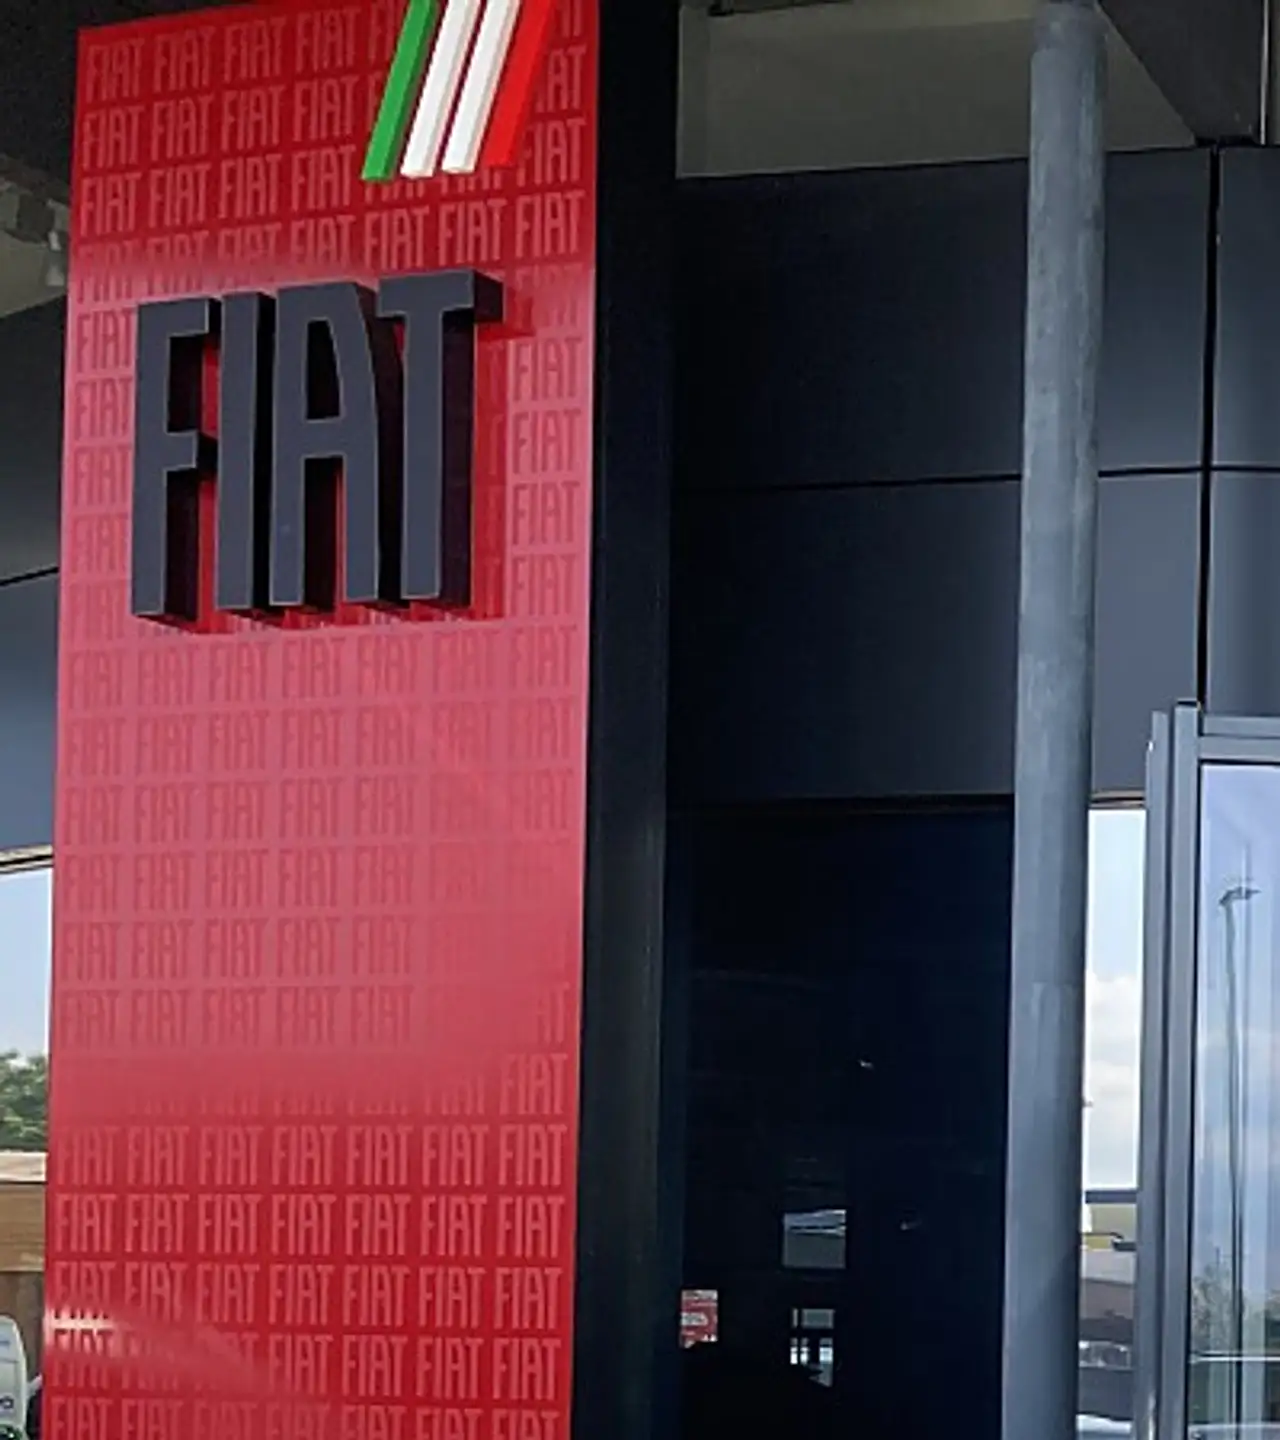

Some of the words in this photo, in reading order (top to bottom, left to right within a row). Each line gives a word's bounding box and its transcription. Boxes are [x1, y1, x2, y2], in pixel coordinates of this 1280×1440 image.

[87, 38, 143, 102] FIAT
[155, 29, 212, 91] FIAT
[224, 19, 283, 81] FIAT
[296, 8, 356, 71] FIAT
[84, 106, 141, 168] FIAT
[153, 97, 210, 159] FIAT
[223, 88, 282, 150] FIAT
[294, 78, 355, 140] FIAT
[82, 174, 139, 235] FIAT
[151, 166, 208, 227] FIAT
[221, 158, 280, 218] FIAT
[293, 149, 354, 210] FIAT
[291, 219, 352, 279] FIAT
[365, 210, 428, 272] FIAT
[440, 201, 505, 264] FIAT
[517, 191, 585, 256] FIAT
[78, 310, 135, 369] FIAT
[76, 378, 133, 437] FIAT
[514, 337, 582, 400] FIAT
[131, 268, 478, 618] FIAT
[513, 409, 581, 472] FIAT
[512, 482, 579, 544] FIAT
[510, 554, 578, 616] FIAT
[69, 650, 127, 707] FIAT
[139, 647, 198, 704] FIAT
[210, 643, 271, 701] FIAT
[283, 639, 345, 698] FIAT
[357, 635, 421, 695] FIAT
[432, 630, 498, 691] FIAT
[509, 626, 577, 688] FIAT
[67, 718, 125, 775] FIAT
[137, 715, 197, 773] FIAT
[208, 712, 269, 770] FIAT
[281, 709, 344, 768] FIAT
[355, 705, 419, 765] FIAT
[431, 702, 497, 762] FIAT
[65, 787, 124, 843] FIAT
[135, 784, 195, 841] FIAT
[207, 781, 268, 839] FIAT
[280, 778, 342, 837] FIAT
[354, 776, 418, 835] FIAT
[134, 853, 194, 910] FIAT
[205, 850, 267, 909] FIAT
[278, 848, 341, 907] FIAT
[353, 846, 417, 906] FIAT
[62, 923, 121, 979] FIAT
[132, 921, 193, 978] FIAT
[204, 920, 266, 978] FIAT
[277, 918, 340, 977] FIAT
[351, 916, 415, 976] FIAT
[60, 991, 120, 1047] FIAT
[131, 990, 192, 1047] FIAT
[202, 989, 264, 1047] FIAT
[275, 987, 339, 1047] FIAT
[350, 986, 414, 1046] FIAT
[500, 1055, 568, 1117] FIAT
[57, 1127, 117, 1183] FIAT
[128, 1127, 189, 1184] FIAT
[199, 1127, 262, 1185] FIAT
[272, 1126, 336, 1186] FIAT
[347, 1126, 411, 1187] FIAT
[422, 1126, 488, 1187] FIAT
[499, 1126, 566, 1188] FIAT
[55, 1195, 116, 1251] FIAT
[126, 1195, 188, 1253] FIAT
[198, 1196, 260, 1254] FIAT
[271, 1196, 334, 1256] FIAT
[345, 1196, 410, 1257] FIAT
[421, 1197, 486, 1258] FIAT
[497, 1197, 564, 1259] FIAT
[124, 1264, 186, 1321] FIAT
[196, 1264, 259, 1323] FIAT
[269, 1265, 333, 1325] FIAT
[344, 1266, 408, 1327] FIAT
[419, 1267, 485, 1329] FIAT
[496, 1268, 562, 1330] FIAT
[268, 1335, 331, 1395] FIAT
[342, 1336, 407, 1397] FIAT
[417, 1338, 483, 1399] FIAT
[494, 1339, 561, 1401] FIAT
